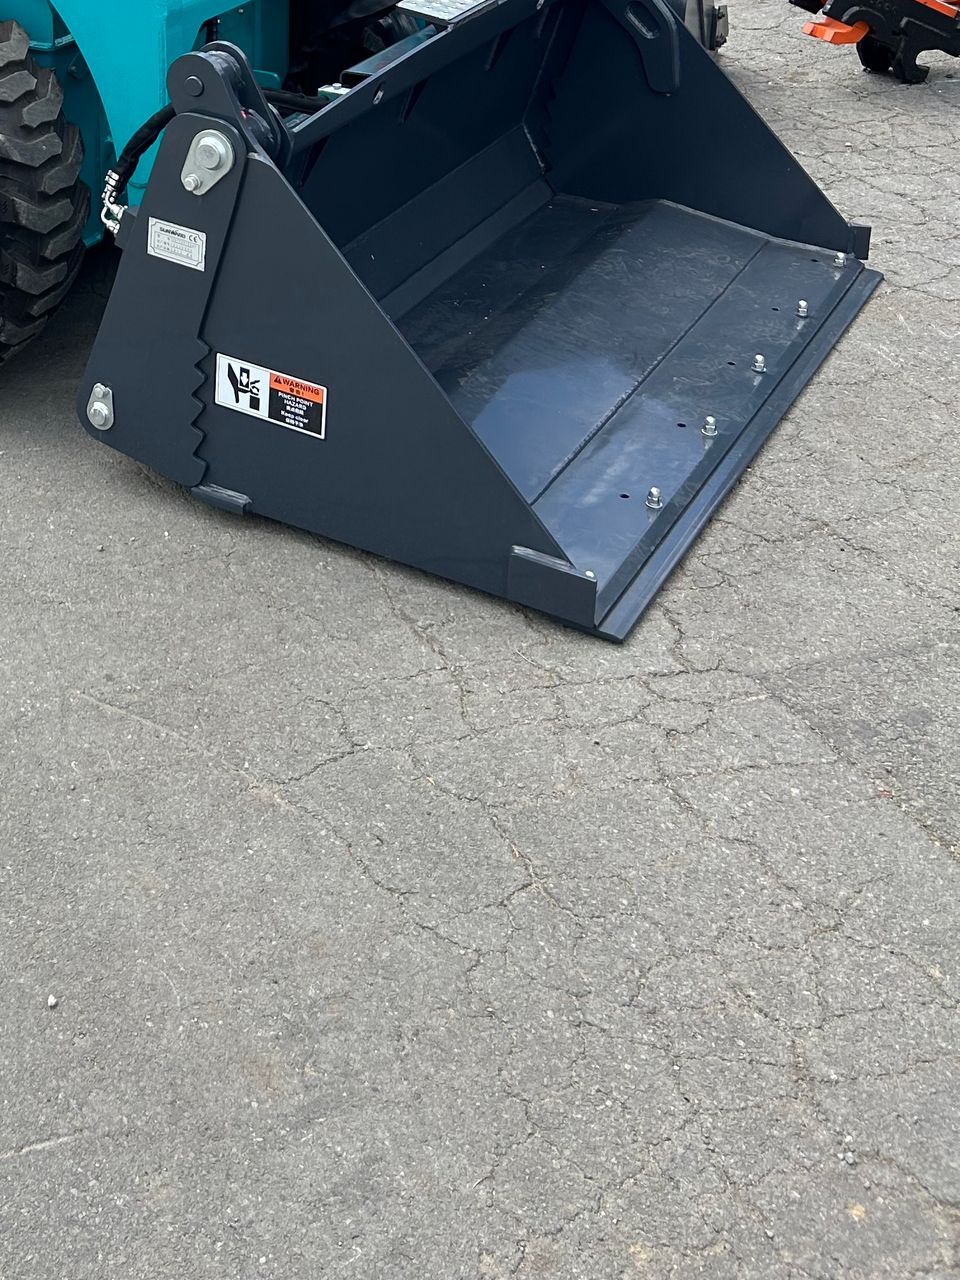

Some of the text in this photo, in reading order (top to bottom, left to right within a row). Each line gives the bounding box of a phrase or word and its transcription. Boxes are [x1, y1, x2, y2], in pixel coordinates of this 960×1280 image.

[159, 226, 186, 239] SUNWARD
[283, 379, 320, 396] WARNING
[278, 392, 314, 407] PINCH POINT
[283, 399, 307, 411] HAZARD
[280, 410, 294, 419] Keep
[295, 414, 309, 423] clear
